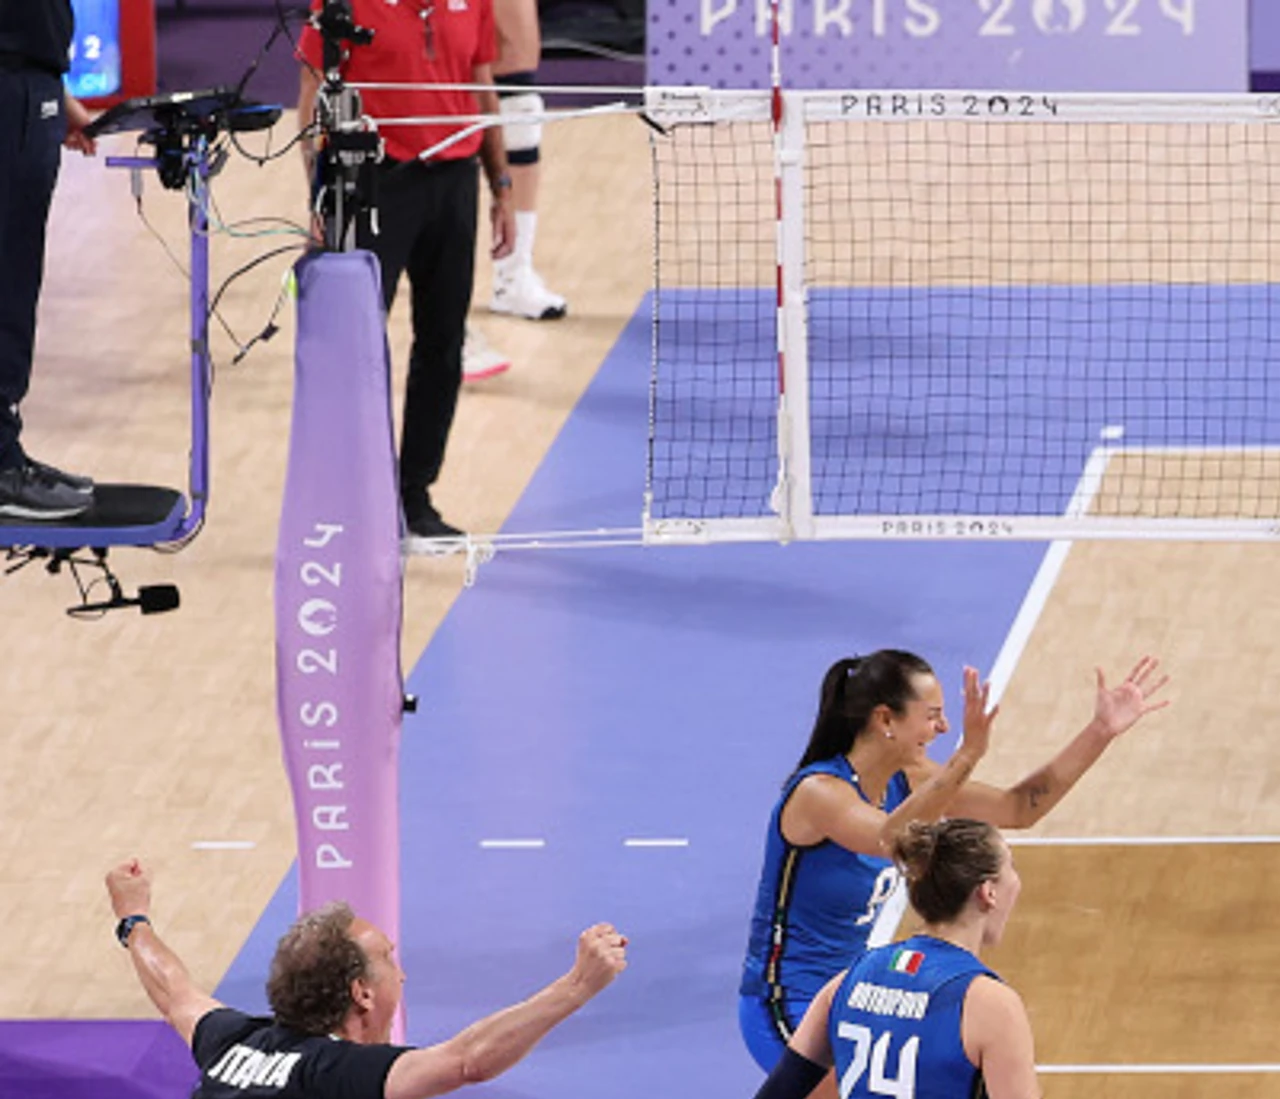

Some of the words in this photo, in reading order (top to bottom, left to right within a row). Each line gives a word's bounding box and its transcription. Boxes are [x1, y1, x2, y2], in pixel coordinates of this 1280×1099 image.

[700, 0, 941, 37] PARIS
[978, 0, 1194, 37] 2024
[840, 94, 946, 116] PARIS
[962, 95, 1058, 116] 2024
[297, 521, 345, 675] 2024
